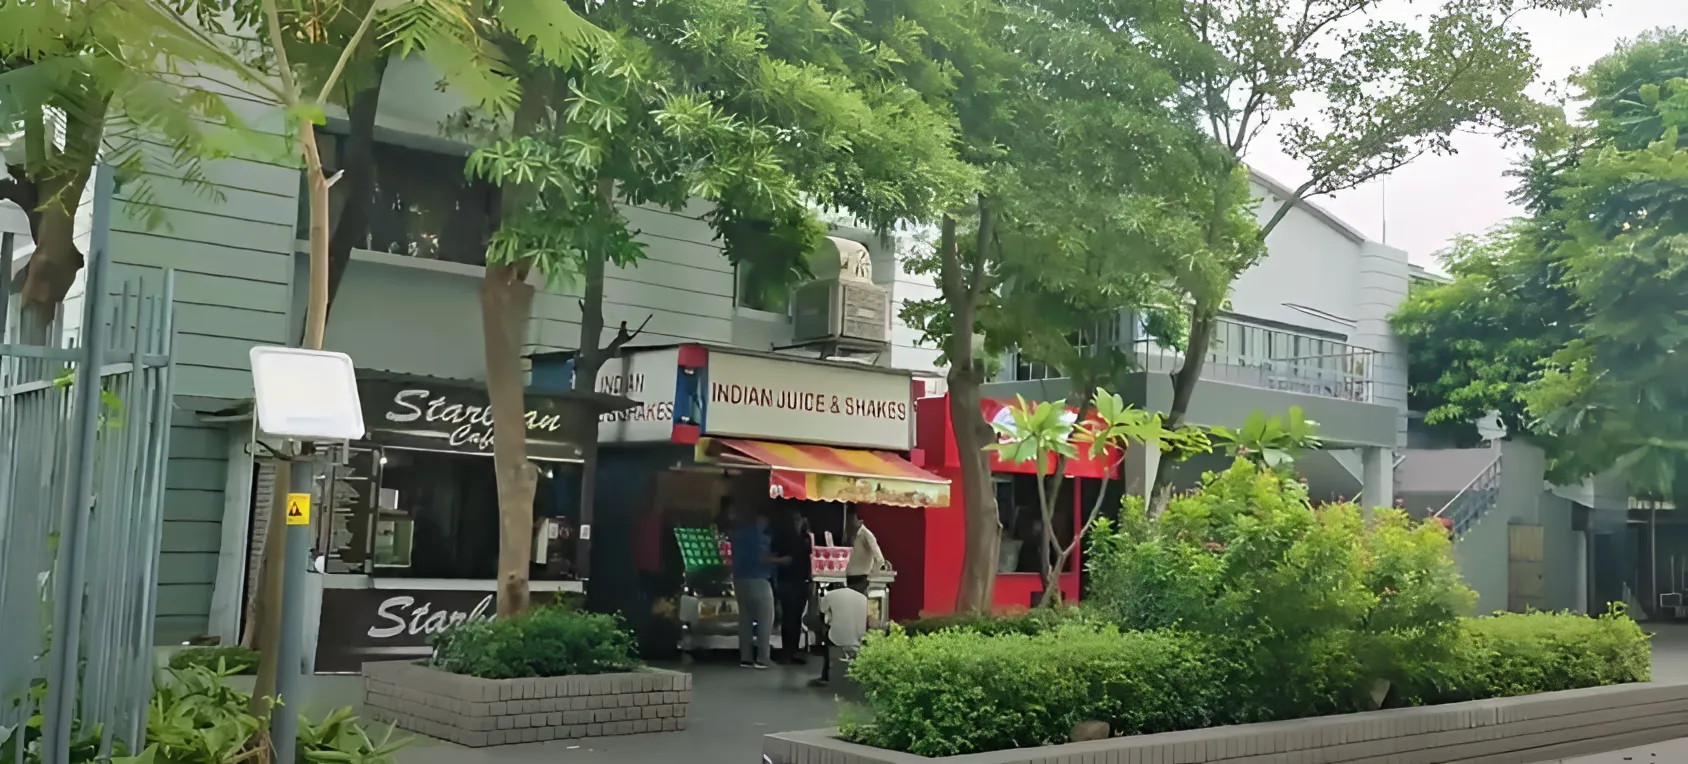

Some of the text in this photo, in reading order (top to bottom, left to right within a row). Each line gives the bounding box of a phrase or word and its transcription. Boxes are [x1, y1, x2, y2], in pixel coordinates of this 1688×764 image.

[600, 373, 645, 394] INDAN
[712, 382, 773, 407] INDIAN
[776, 390, 825, 413] JUICE
[830, 395, 840, 414] &
[845, 397, 906, 421] SHAKES
[449, 423, 495, 449] Caf
